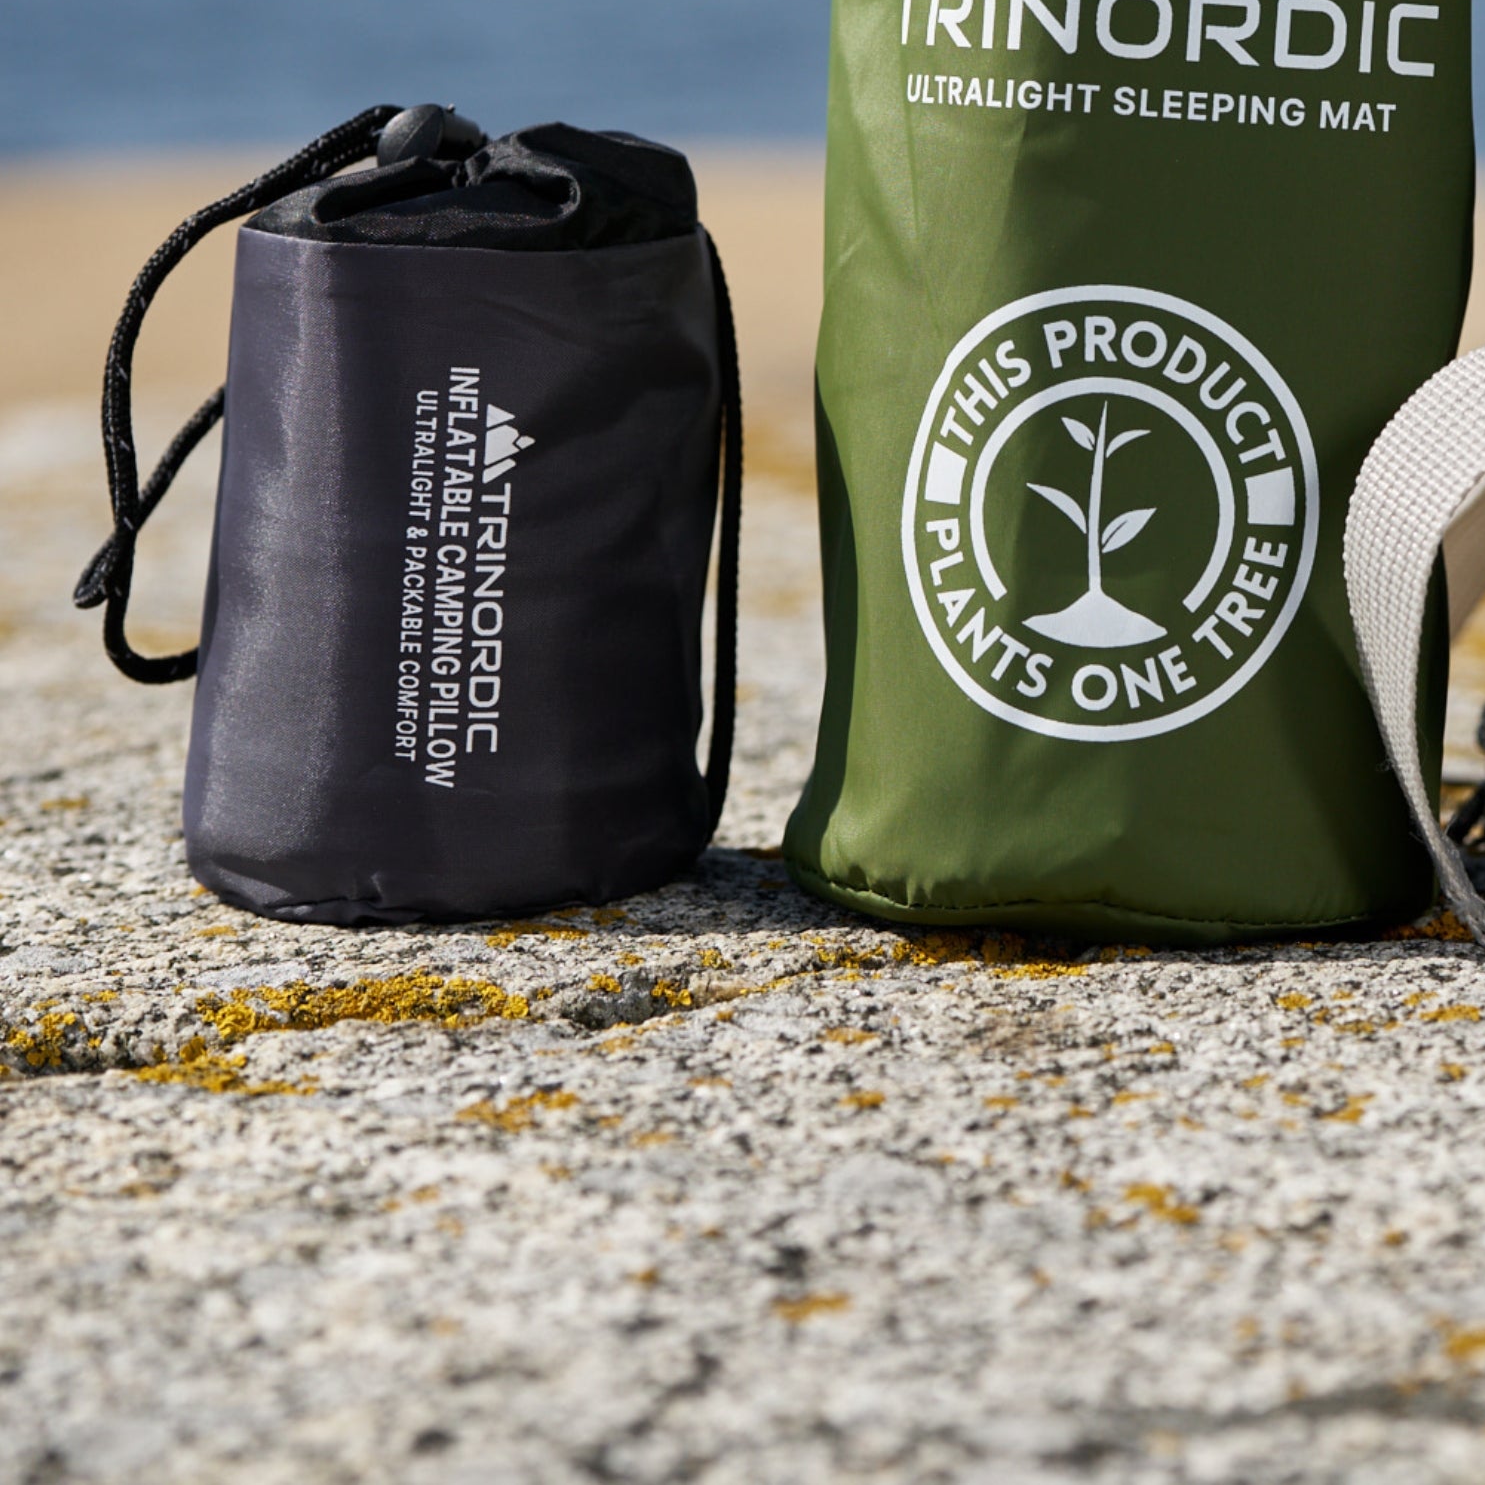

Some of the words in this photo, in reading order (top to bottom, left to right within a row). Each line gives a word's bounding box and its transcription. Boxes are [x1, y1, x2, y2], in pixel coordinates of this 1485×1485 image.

[906, 73, 1101, 114] ULTRALIGHT
[1113, 86, 1306, 128] SLEEPING
[1319, 101, 1397, 133] MAT
[438, 367, 480, 537] INFLATABLE
[940, 339, 1032, 446] THIS
[1043, 315, 1287, 464] PRODUCT
[408, 390, 439, 521] ULTRALIGHT
[405, 525, 429, 540] &
[399, 546, 428, 654] PACKABLE
[430, 544, 468, 676] CAMPING
[465, 482, 512, 753] TRINORDIC
[925, 517, 1054, 698] PLANTS
[1071, 645, 1198, 711] ONE
[1191, 536, 1289, 660] TREE
[394, 659, 421, 762] COMFORT
[424, 682, 460, 789] PILLOW
